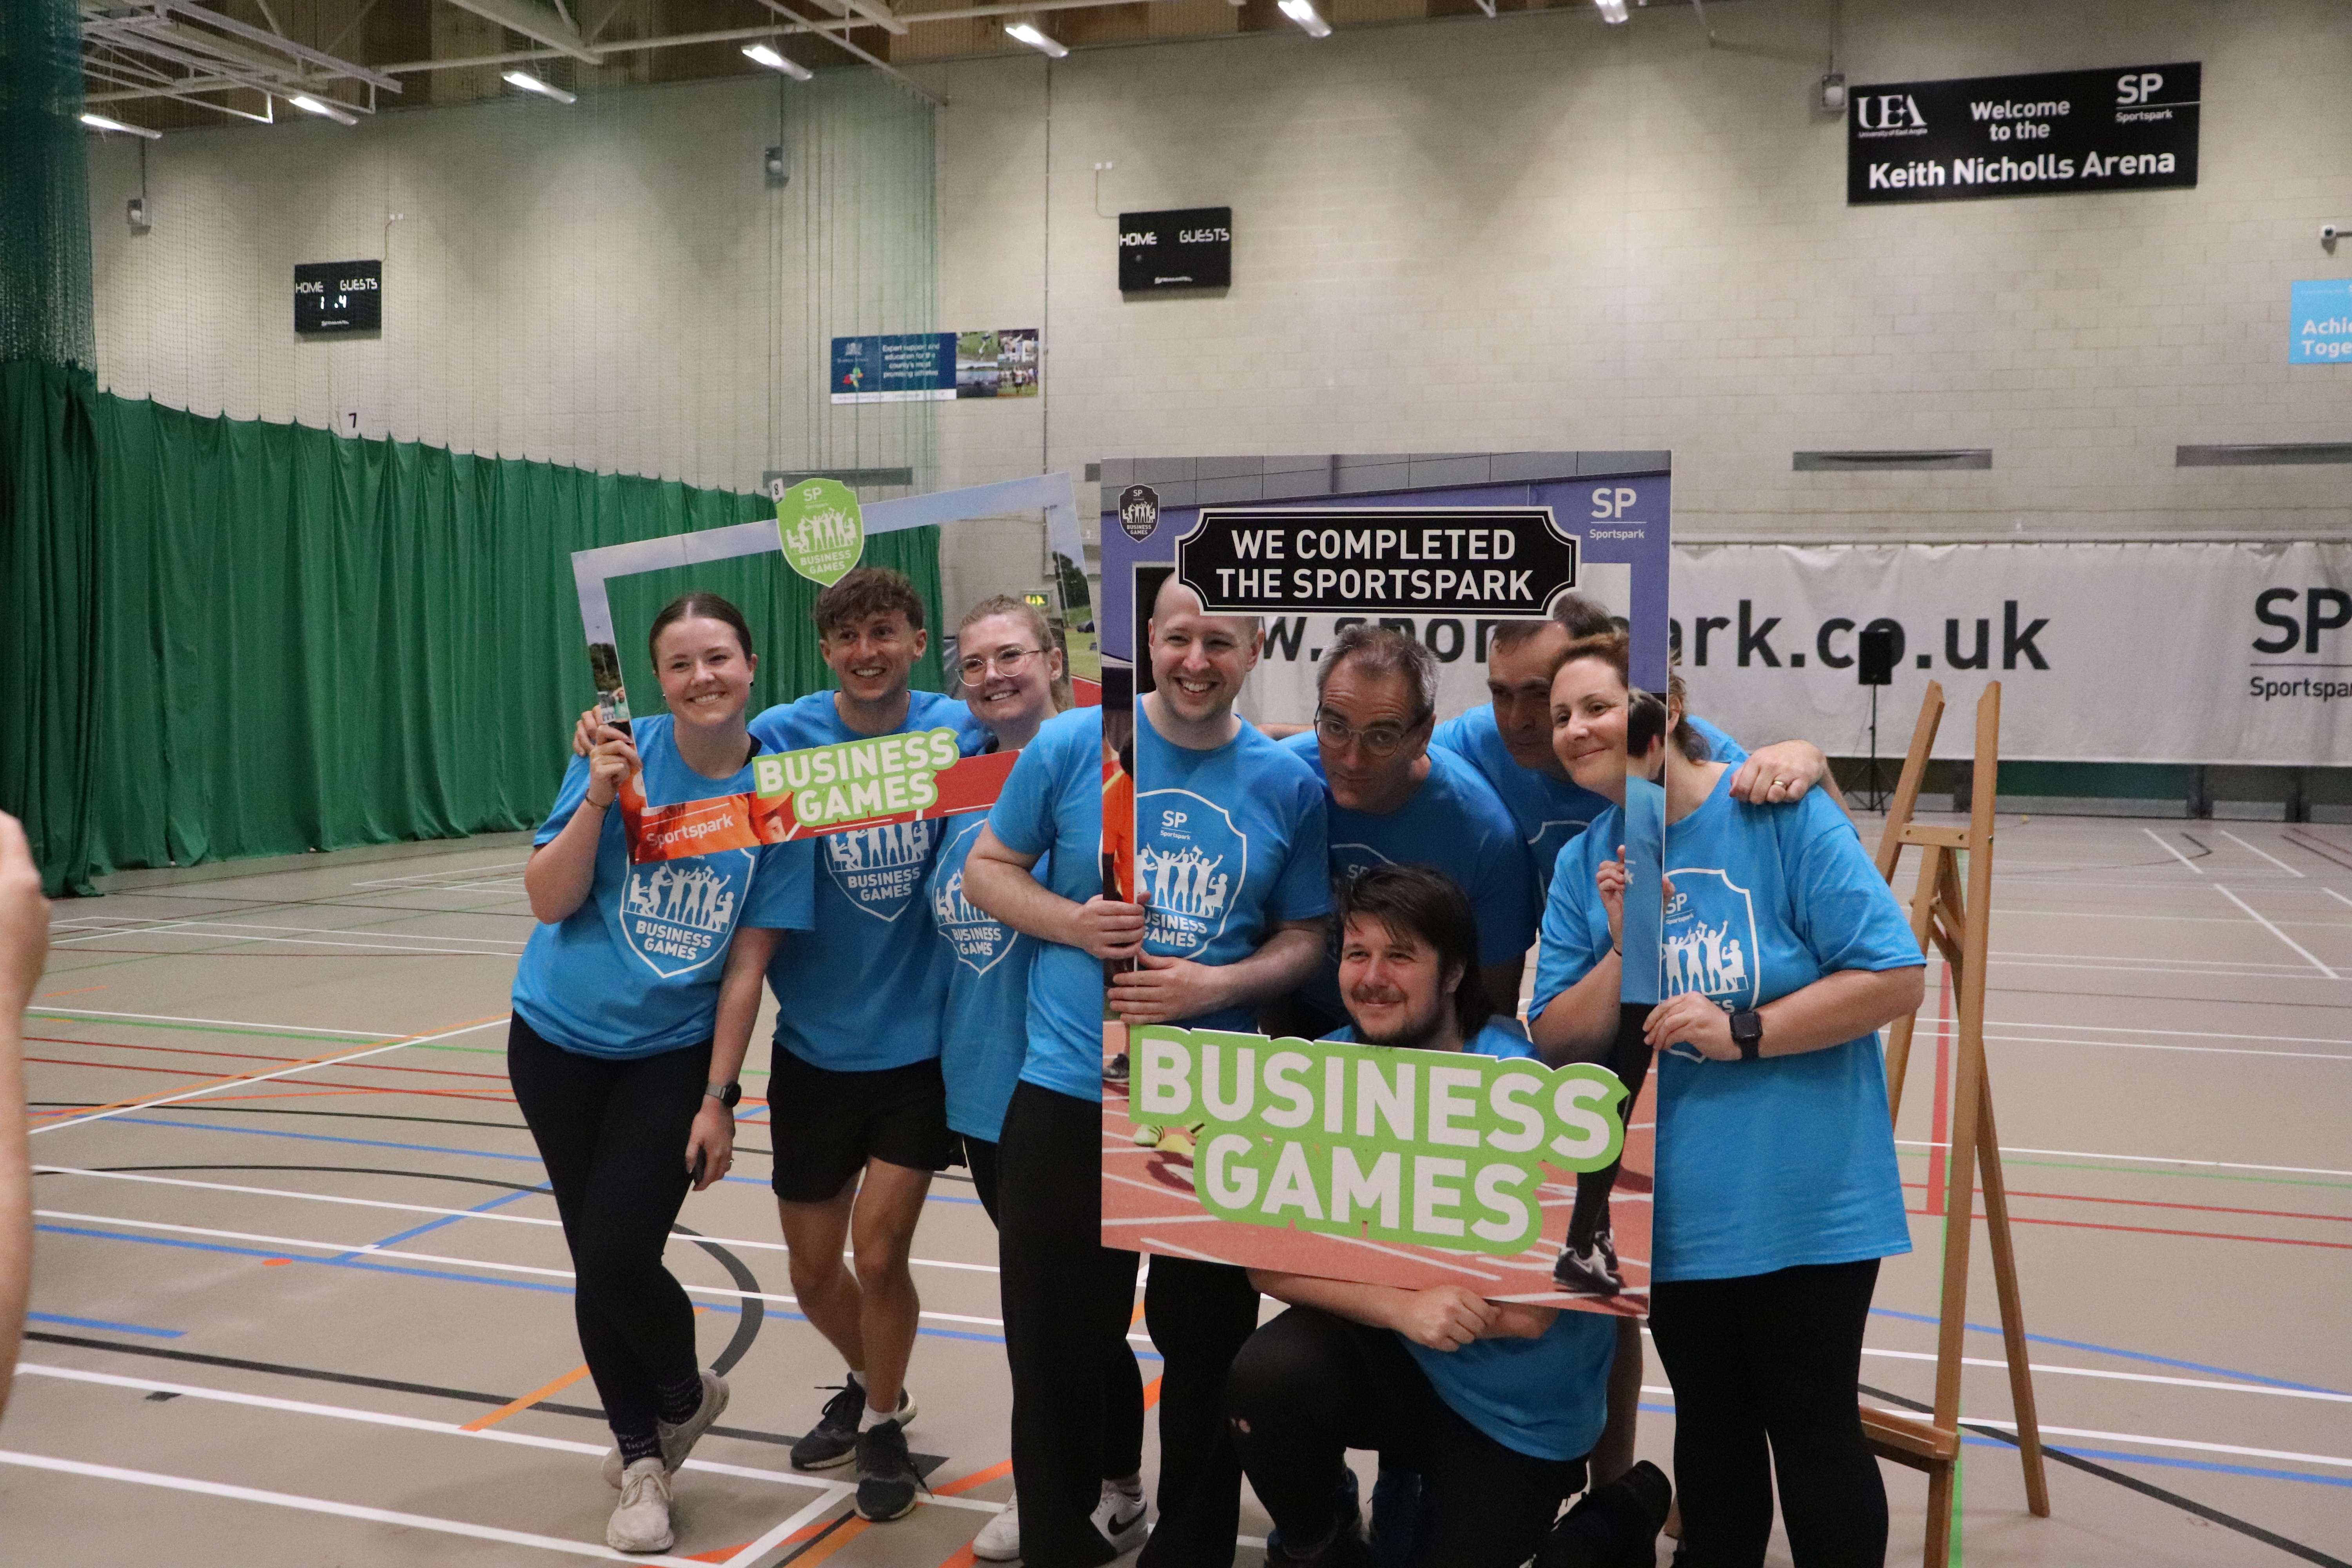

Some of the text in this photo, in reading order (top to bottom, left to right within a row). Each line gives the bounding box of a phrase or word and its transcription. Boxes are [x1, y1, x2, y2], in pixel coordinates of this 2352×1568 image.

[2117, 73, 2164, 104] SP
[1857, 94, 1927, 129] UEA
[1970, 100, 2070, 121] Welcome
[2116, 109, 2173, 124] Sportspark
[1989, 121, 2051, 141] to the
[1869, 151, 2175, 189] Keith Nicholls Arena
[1120, 228, 1230, 247] HOME GUESTS
[296, 278, 377, 294] HOME GUESTS
[348, 413, 357, 428] 7
[774, 483, 779, 495] 8
[804, 488, 822, 502] SP
[1591, 487, 1637, 519] SP
[1232, 529, 1515, 560] WE COMPLETED
[1590, 528, 1645, 541] Sportspark
[800, 550, 851, 566] BUSINESS
[809, 561, 845, 575] GAMES
[1216, 569, 1534, 601] THE SPORTSPARK
[2252, 588, 2352, 653] SP
[758, 733, 955, 793] BUSINESS
[797, 772, 933, 822] GAMES
[1161, 810, 1187, 828] SP
[646, 813, 734, 849] Sportspark
[1160, 830, 1191, 840] Sportspark
[848, 867, 920, 888] BUSINESS
[860, 883, 912, 901] GAMES
[1145, 911, 1207, 934] USINESS
[636, 920, 711, 948] BUSINESS
[951, 927, 1002, 941] BUSINESS
[644, 938, 697, 960] GAMES
[960, 942, 993, 956] GAMES
[1141, 1039, 1610, 1159] BUSINESS
[1205, 1134, 1529, 1242] GAMES
